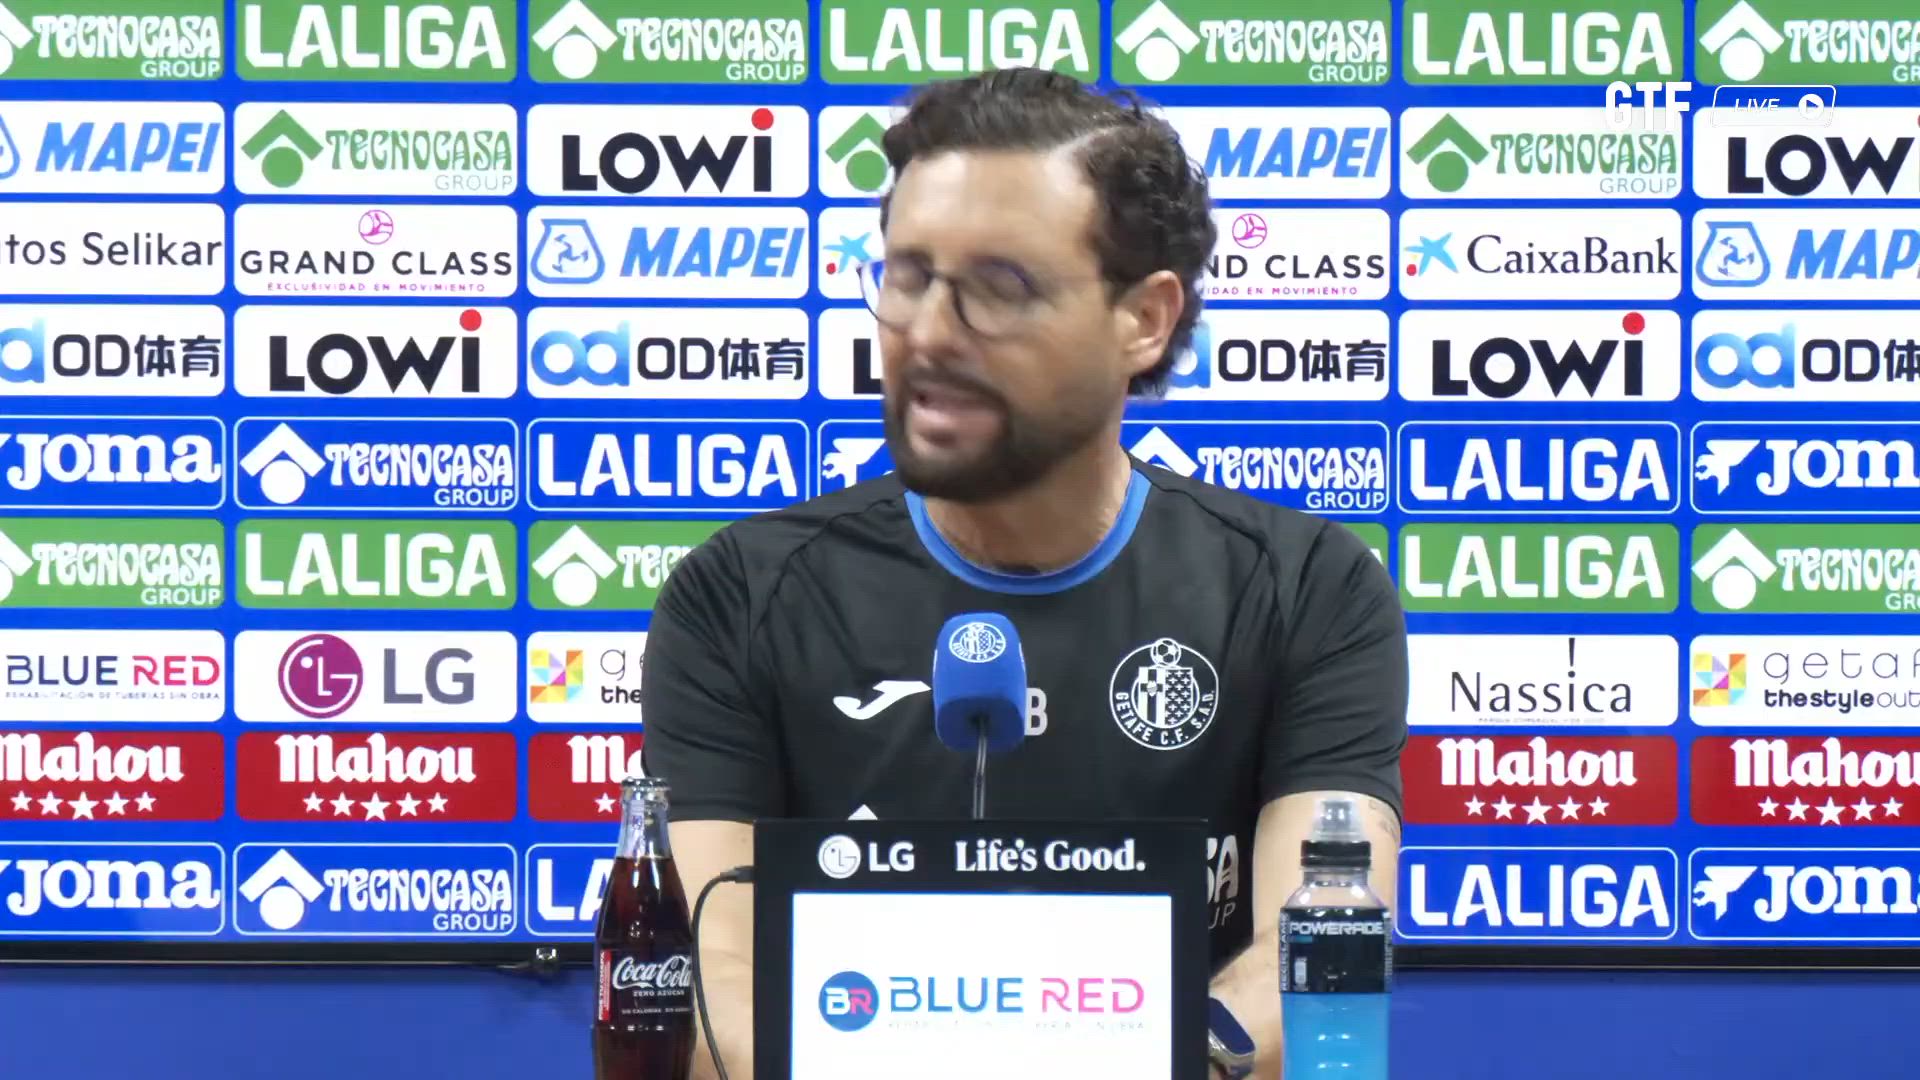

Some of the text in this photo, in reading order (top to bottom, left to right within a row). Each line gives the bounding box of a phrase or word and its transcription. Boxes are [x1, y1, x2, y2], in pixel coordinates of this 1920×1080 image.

[245, 4, 506, 69] LALIGA
[827, 6, 1093, 75] LALIGA
[1413, 12, 1672, 75] LALIGA
[141, 58, 222, 80] GROUP
[726, 61, 806, 83] GROUP
[1309, 64, 1388, 84] GROUP
[35, 122, 221, 172] MAPEI
[1203, 127, 1388, 180] MAPEI
[1724, 130, 1920, 198] LOW
[435, 175, 514, 193] GROUP
[1600, 178, 1678, 195] GROUP
[83, 232, 222, 266] Selikar
[241, 250, 511, 275] GRAND CLASS
[620, 227, 805, 277] MAPEI
[1265, 255, 1384, 279] CLASS
[1467, 235, 1678, 273] CaixaBank
[1784, 227, 1920, 281] MAP
[399, 284, 484, 292] MOVIMIENTO
[1247, 287, 1263, 295] EN
[1272, 287, 1357, 295] MOVIMIENTO
[1801, 336, 1920, 384] OD体
[538, 433, 797, 497] LALIGA
[1410, 438, 1670, 501] LALIGA
[1754, 438, 1920, 498] Jom
[432, 486, 515, 508] GROUP
[1306, 489, 1387, 510] GROUP
[246, 533, 506, 597] LALIGA
[1405, 535, 1664, 598] LALIGA
[1776, 546, 1920, 592] TECNOCA
[141, 586, 222, 607] GROUP
[6, 655, 220, 686] BLUE RED
[384, 648, 474, 704] LG
[1452, 638, 1630, 712] Nassica
[1114, 690, 1154, 742] GETAFE
[0, 730, 185, 784] Mahou
[274, 731, 477, 783] Mahou
[1437, 735, 1638, 786] Mahou
[1728, 736, 1920, 787] Mahou
[869, 839, 1145, 871] LG Life's Good.
[1411, 864, 1670, 927] LALIGA
[1751, 864, 1920, 924] Jom
[433, 913, 513, 932] GROUP
[1288, 921, 1386, 936] POWERADE
[889, 977, 1144, 1013] BLUE RED
